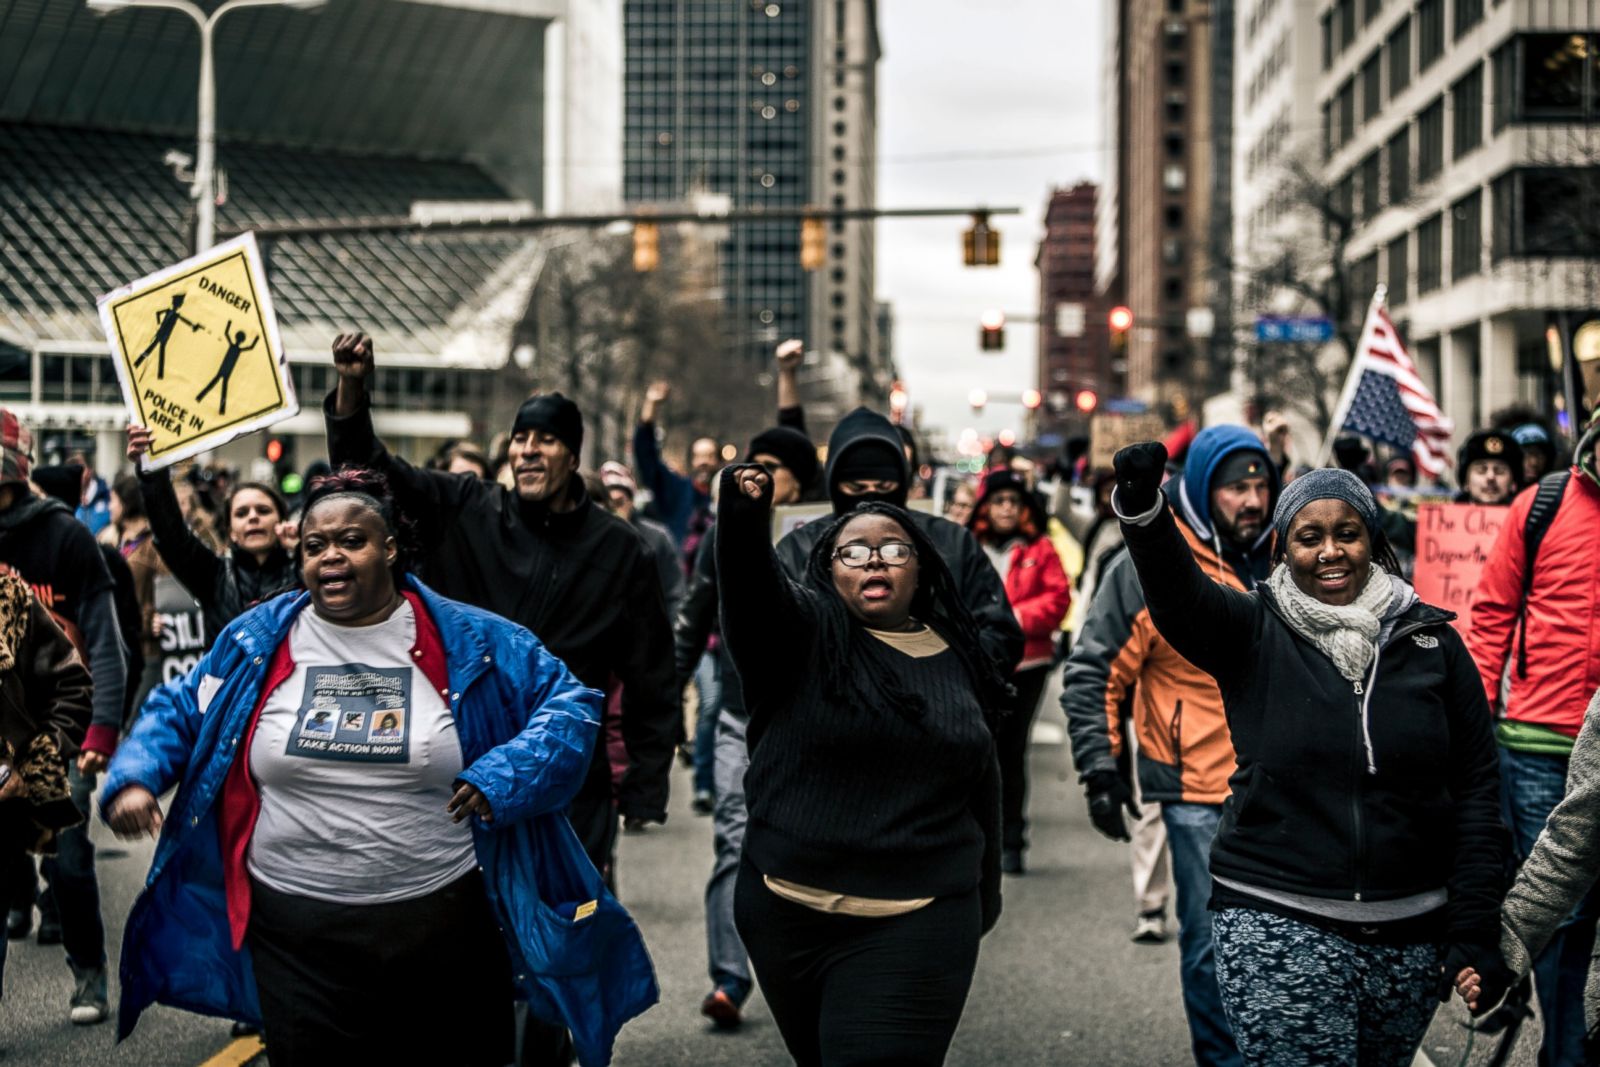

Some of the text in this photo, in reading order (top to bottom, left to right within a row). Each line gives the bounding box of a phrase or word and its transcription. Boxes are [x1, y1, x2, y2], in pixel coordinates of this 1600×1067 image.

[199, 277, 252, 314] DANGER
[144, 389, 204, 431] POLICE IN
[148, 411, 182, 436] AREA
[1438, 571, 1473, 604] Ter
[297, 738, 402, 755] TAKE ACTION NOW!
